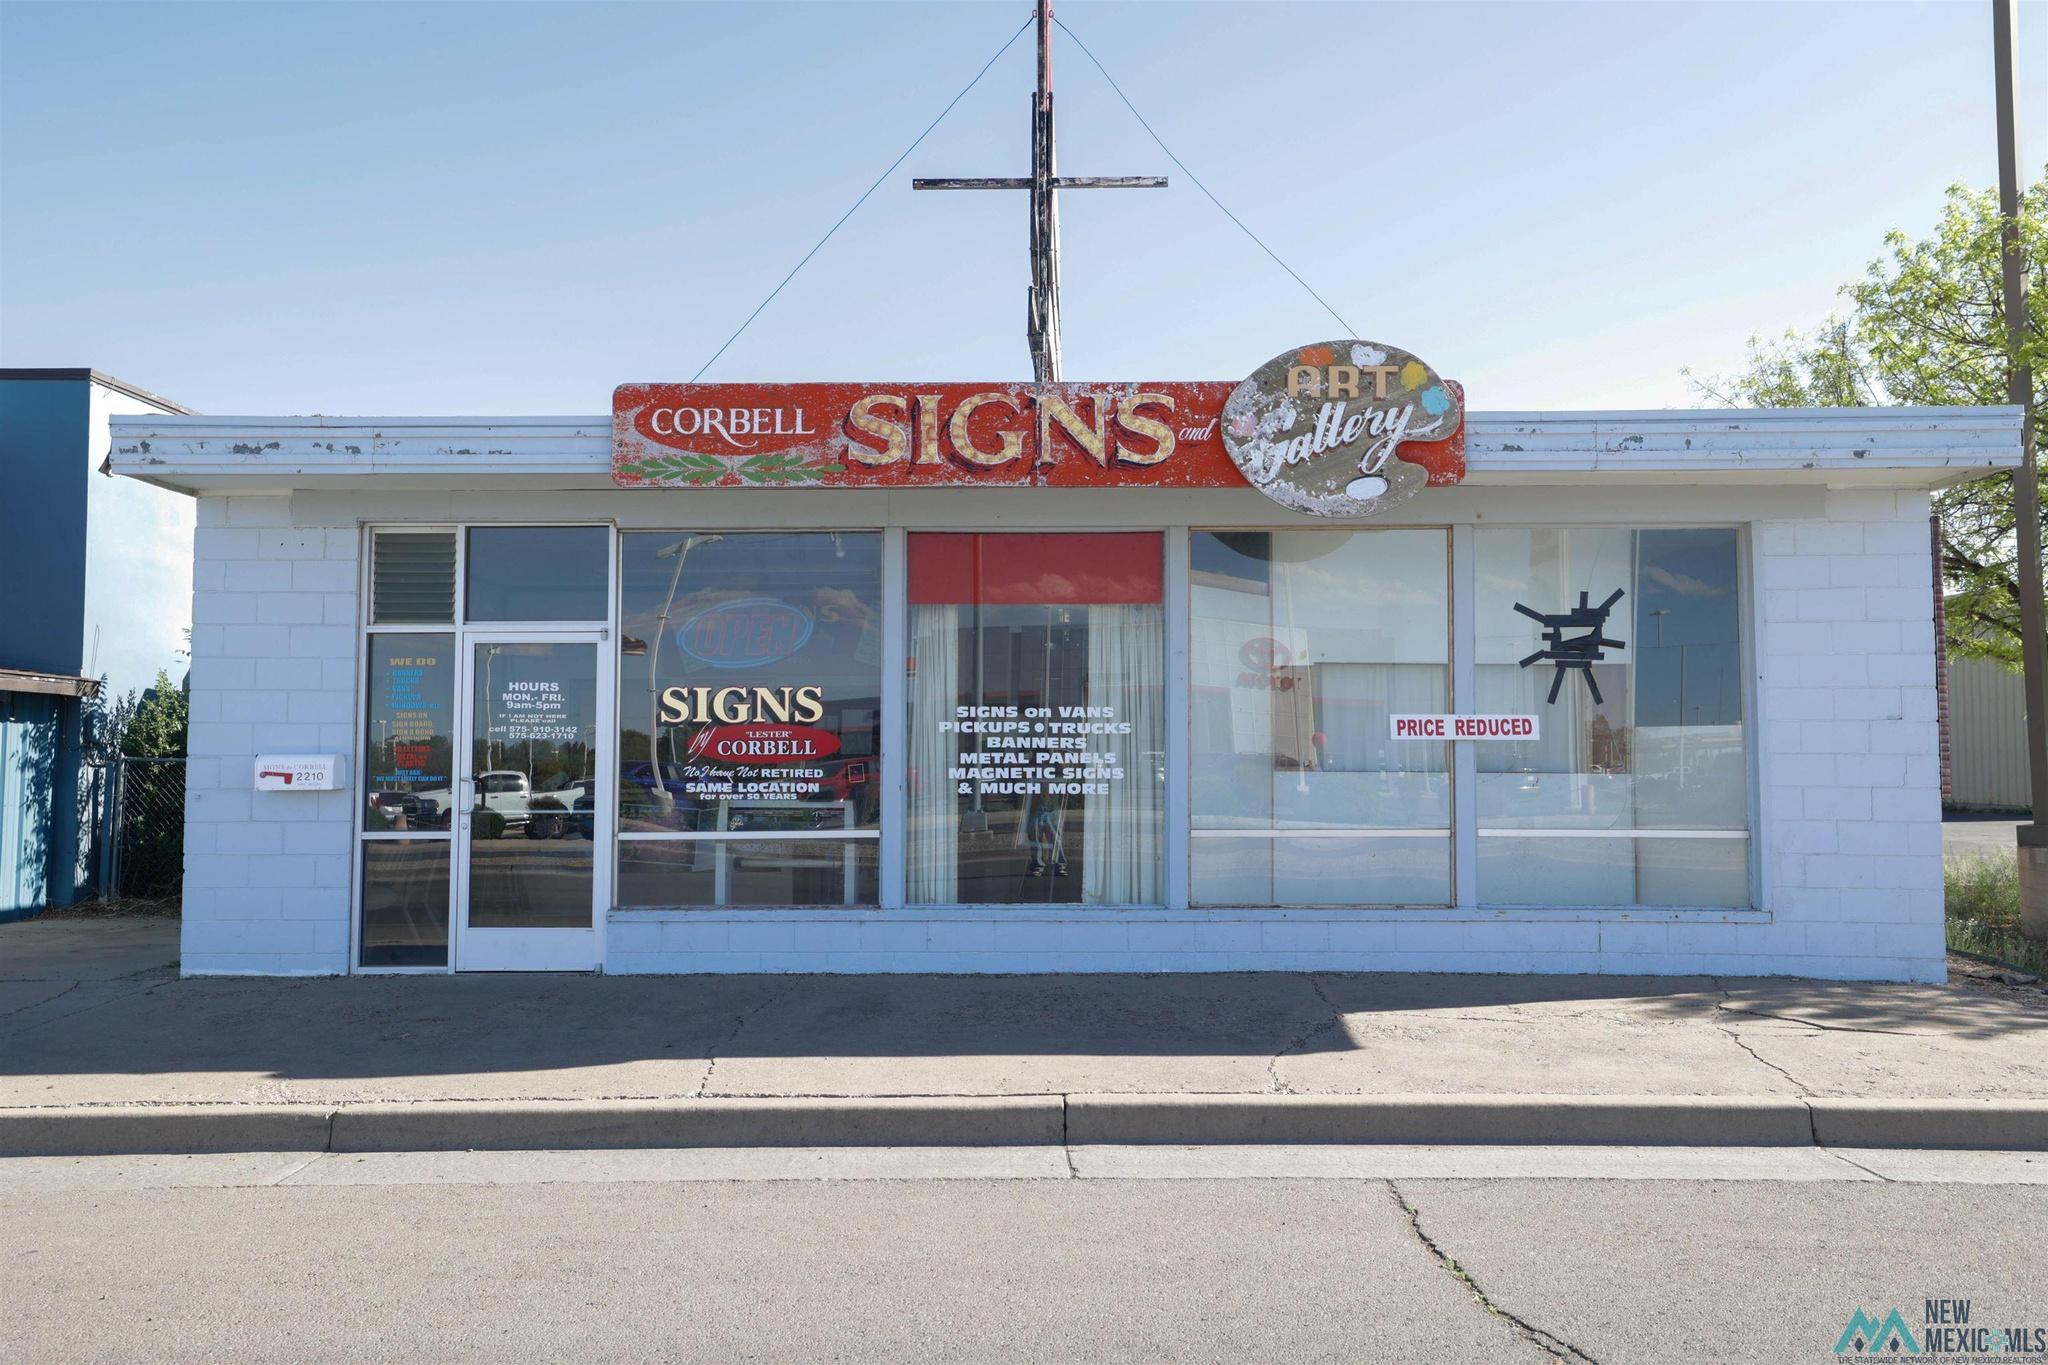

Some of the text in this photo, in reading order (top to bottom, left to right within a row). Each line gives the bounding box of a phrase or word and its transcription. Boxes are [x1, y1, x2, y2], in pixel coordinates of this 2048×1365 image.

[1286, 365, 1399, 399] ART
[651, 407, 815, 448] CORBELL
[842, 391, 1217, 473] SIGNS and
[695, 613, 797, 656] OPEN
[389, 657, 437, 666] WE DO
[541, 693, 565, 701] FRI.
[506, 701, 561, 711] 9am-5pm
[658, 686, 824, 726] SIGNS
[956, 706, 1114, 718] SIGNS on VANS
[489, 725, 507, 733] cell
[938, 722, 1131, 734] PICKUPS TRUCKS
[1396, 718, 1533, 737] PRICE REDUCED
[508, 732, 574, 740] 575-623-1710
[717, 740, 817, 756] CORBELL
[986, 737, 1087, 749] BANNERS
[960, 753, 1116, 764] METAL PANELS
[296, 772, 324, 781] 2210
[683, 765, 700, 777] No
[709, 765, 735, 777] have
[736, 765, 759, 777] Not
[761, 768, 824, 778] RETIRED
[948, 768, 1124, 779] MAGNETIC SIGNS
[685, 782, 820, 793] SAME LOCATION
[957, 783, 1109, 795] & MUCH MORE
